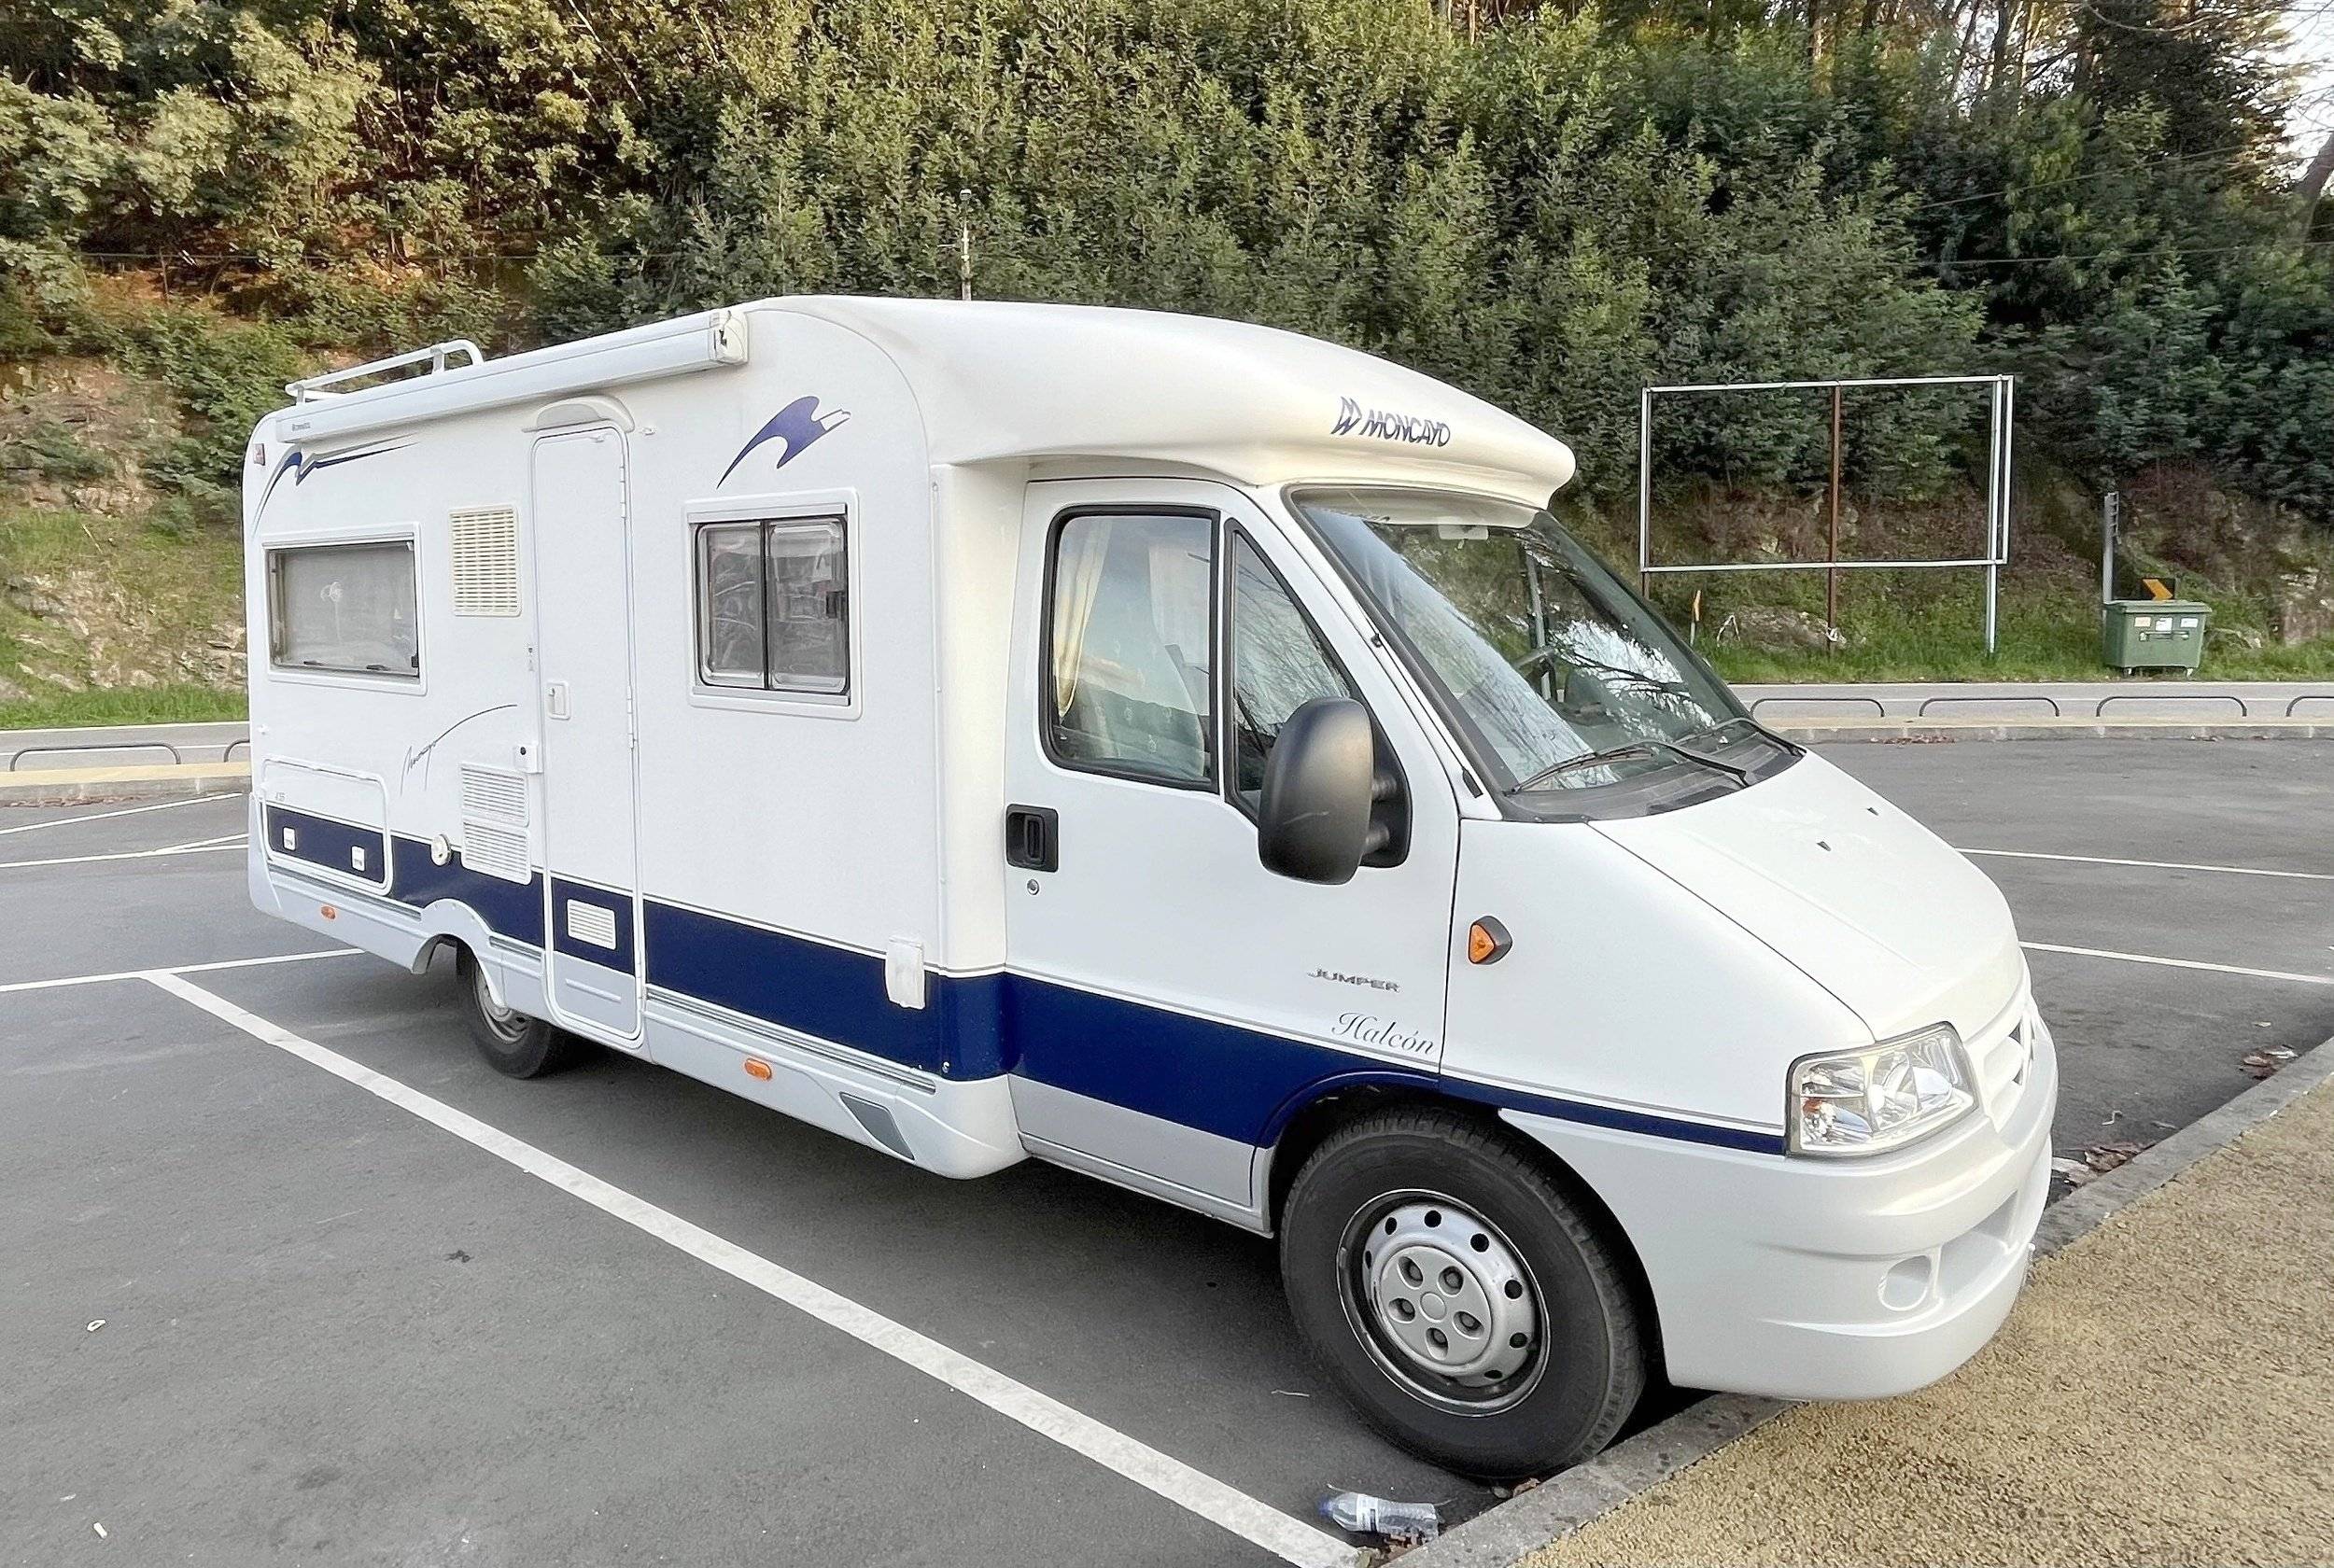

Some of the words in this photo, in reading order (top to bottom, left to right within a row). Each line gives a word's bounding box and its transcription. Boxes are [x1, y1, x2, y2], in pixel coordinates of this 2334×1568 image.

[1359, 409, 1451, 447] MONCAYO
[1307, 968, 1400, 992] JUMPER
[1331, 1012, 1434, 1055] Halcón
